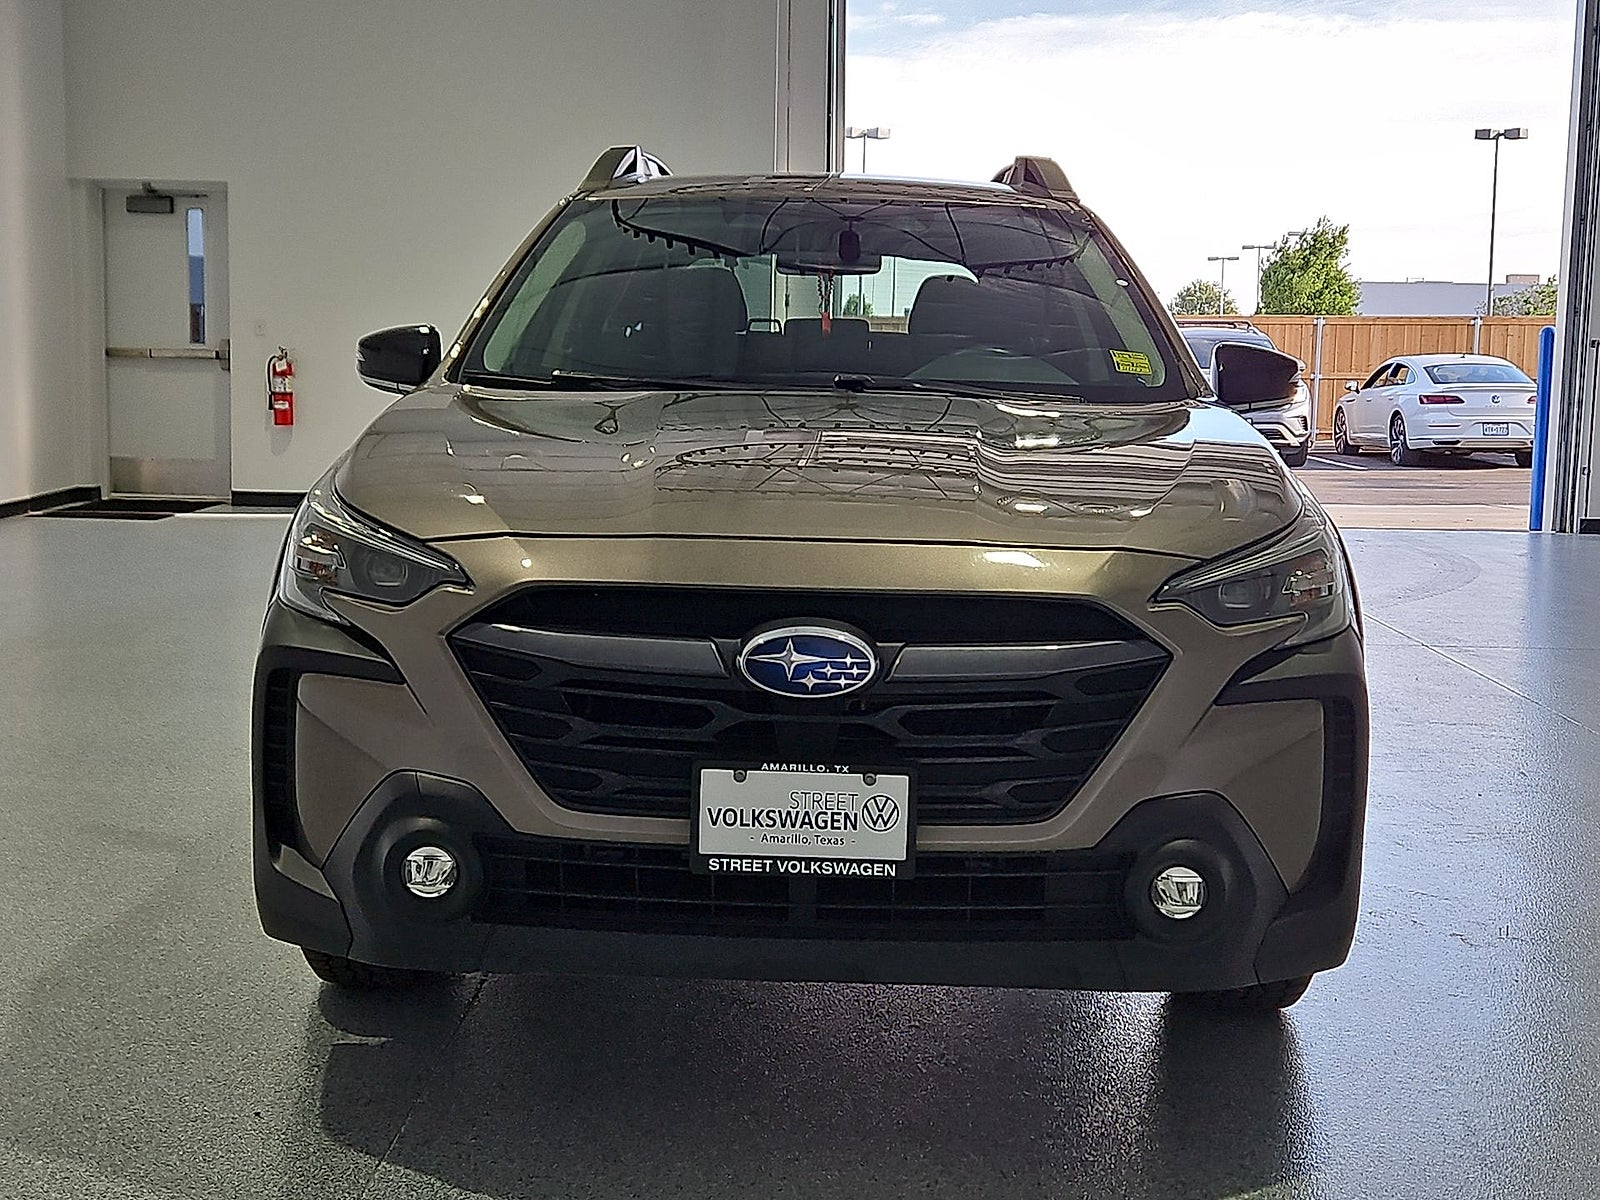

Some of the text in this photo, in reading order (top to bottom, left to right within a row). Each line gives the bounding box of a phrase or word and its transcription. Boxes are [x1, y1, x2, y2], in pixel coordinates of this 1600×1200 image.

[834, 764, 850, 773] TX
[789, 791, 859, 811] STREET
[706, 807, 859, 831] VOLKSWAGEN
[760, 833, 811, 846] Amarillo,
[814, 834, 845, 846] Texas
[708, 858, 896, 877] STREET VOLKSWAGEN
